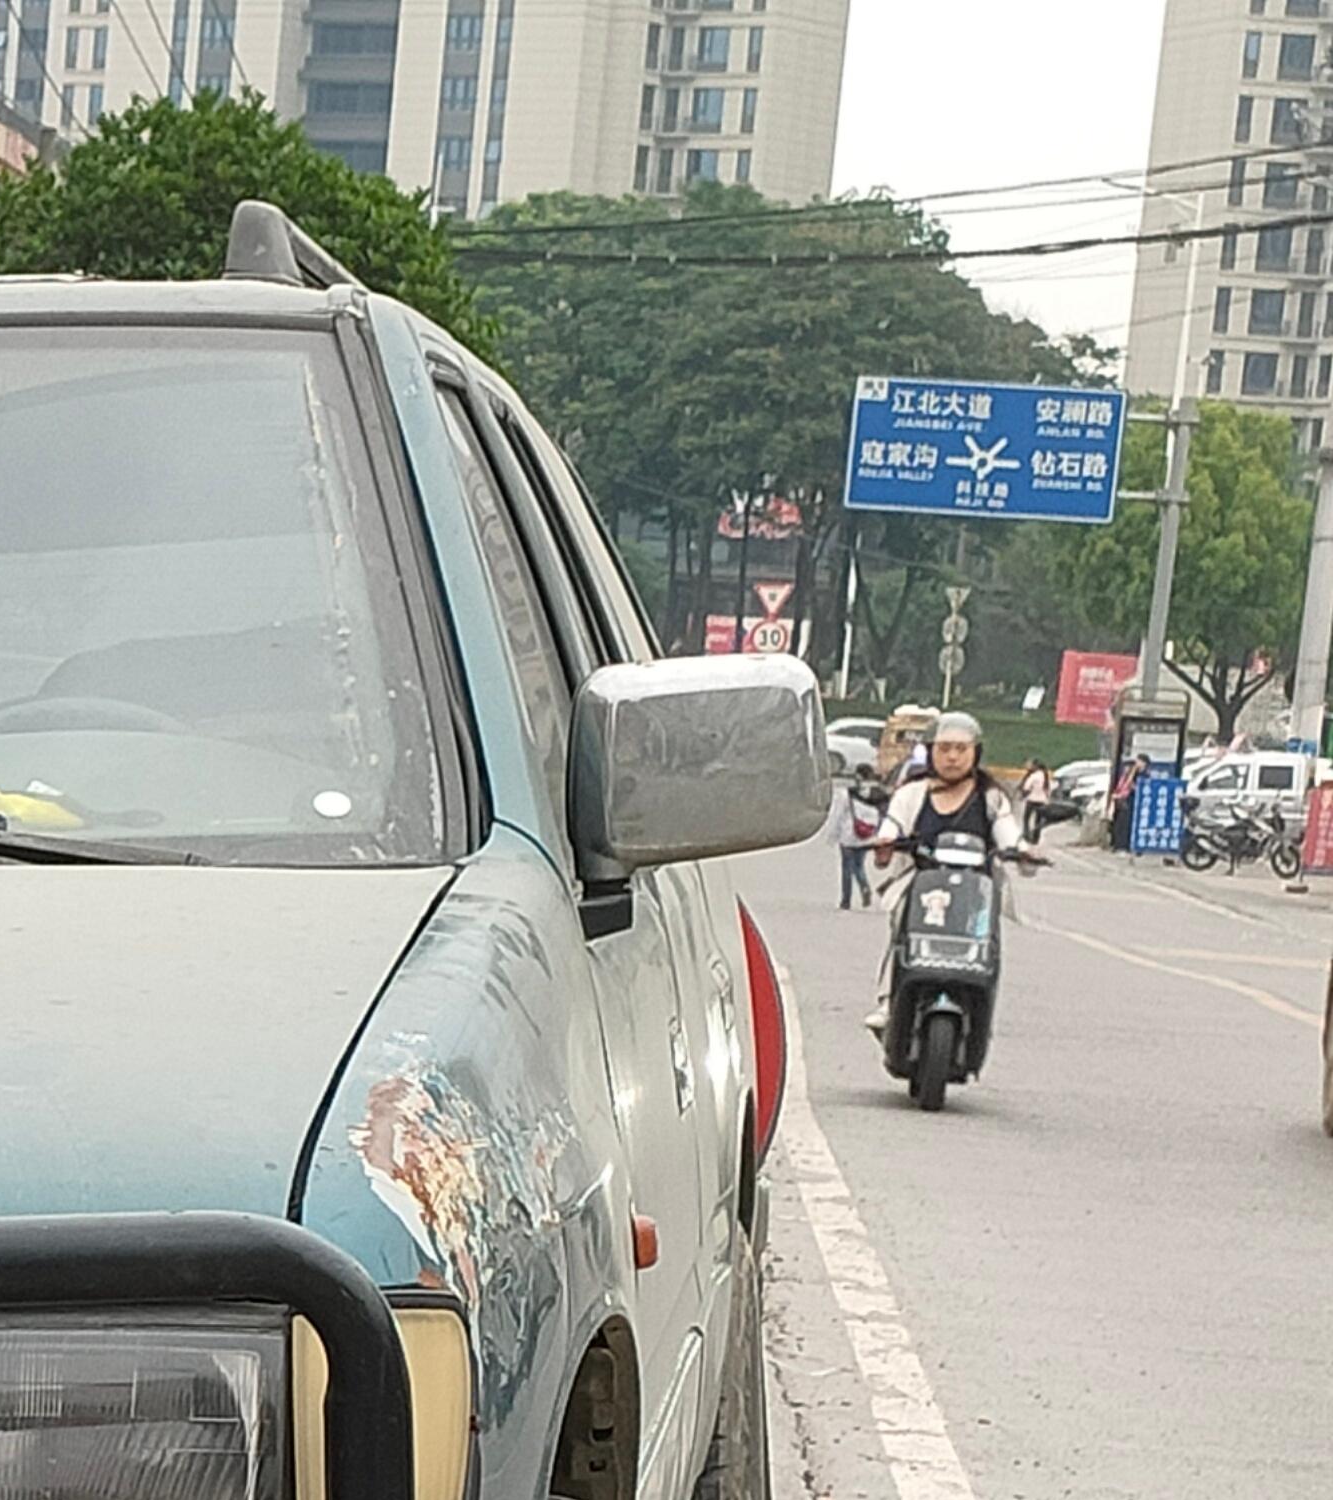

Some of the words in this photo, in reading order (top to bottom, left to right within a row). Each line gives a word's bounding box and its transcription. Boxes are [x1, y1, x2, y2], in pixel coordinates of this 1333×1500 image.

[891, 388, 993, 420] 江北大道
[1031, 449, 1108, 478] 钻石路
[758, 629, 782, 646] 30
